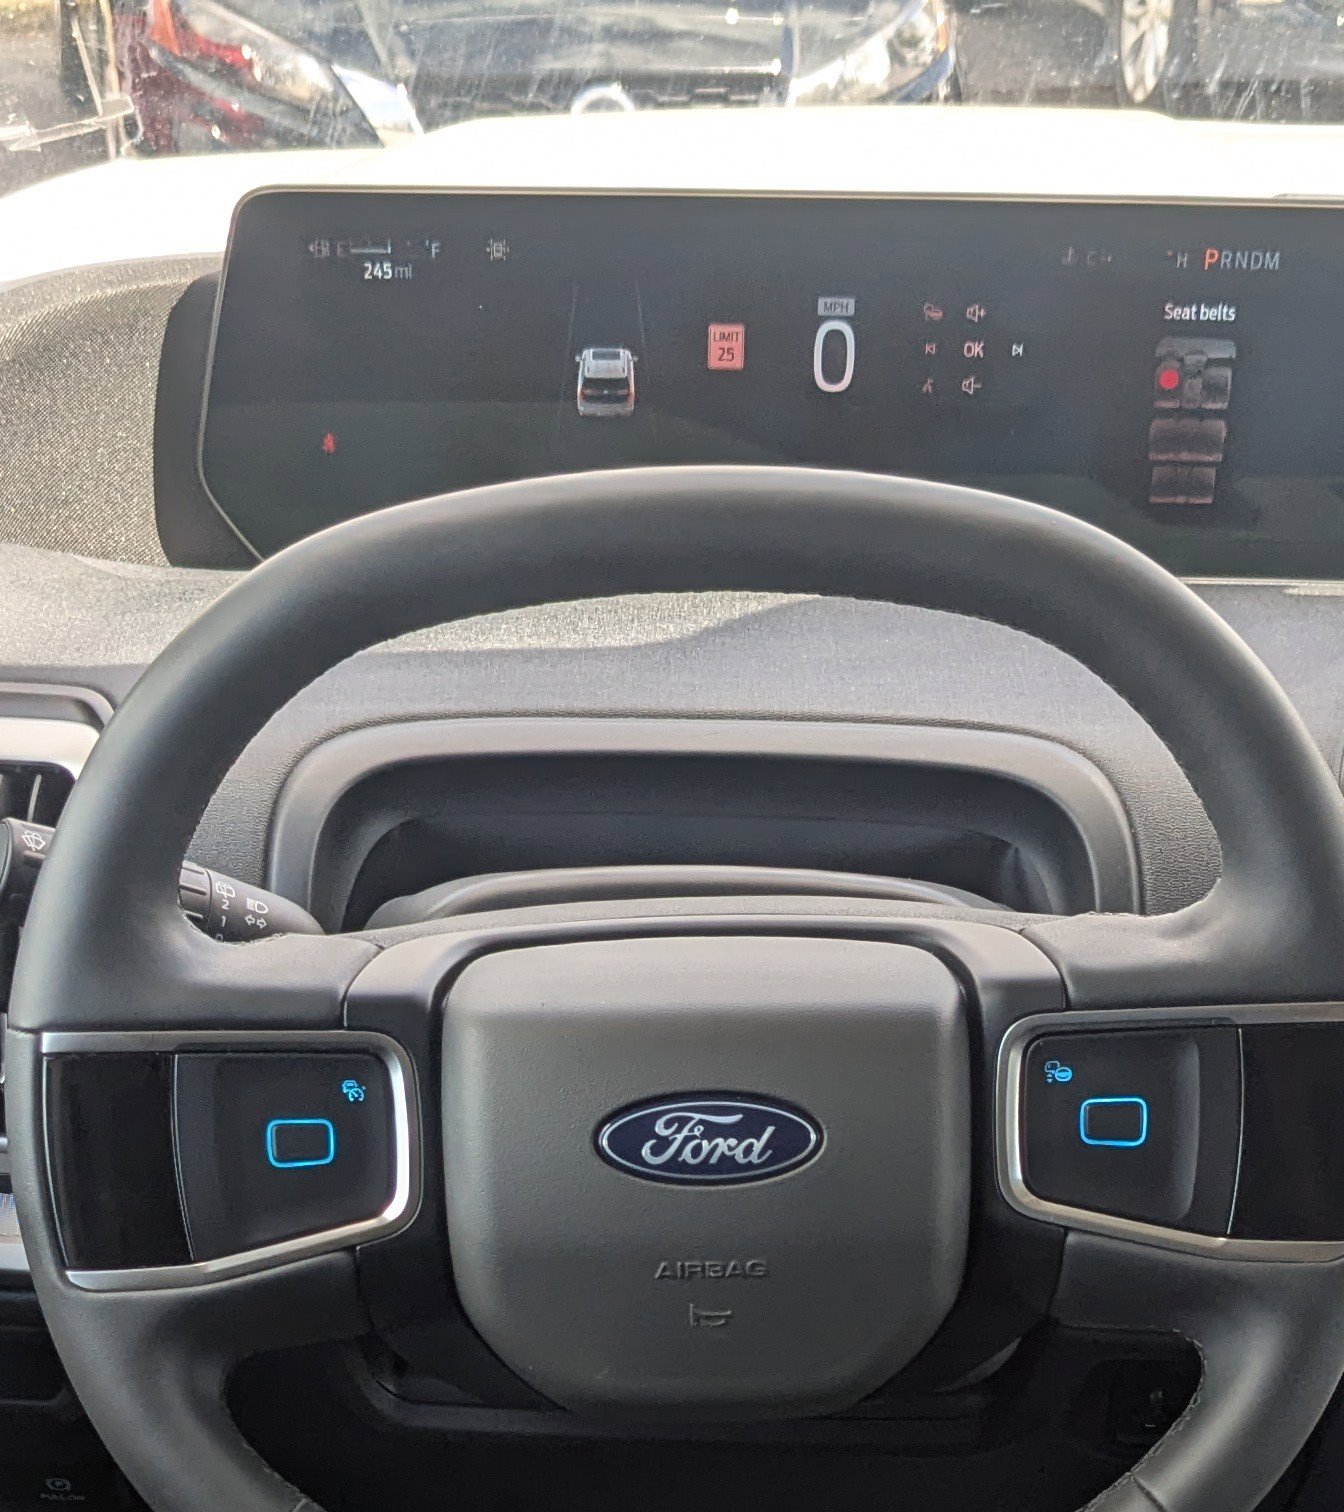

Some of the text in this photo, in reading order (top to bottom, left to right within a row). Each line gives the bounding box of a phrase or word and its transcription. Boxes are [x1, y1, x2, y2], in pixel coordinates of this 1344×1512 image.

[363, 262, 412, 280] 245 mi
[823, 302, 850, 313] MPH
[1164, 301, 1236, 322] Seat belts
[713, 331, 740, 343] LIMIT
[718, 347, 735, 362] 25
[813, 320, 855, 393] 0
[963, 341, 984, 359] OK
[221, 899, 230, 910] 2
[641, 1111, 776, 1165] Ford
[655, 1259, 769, 1280] AIRBAG
